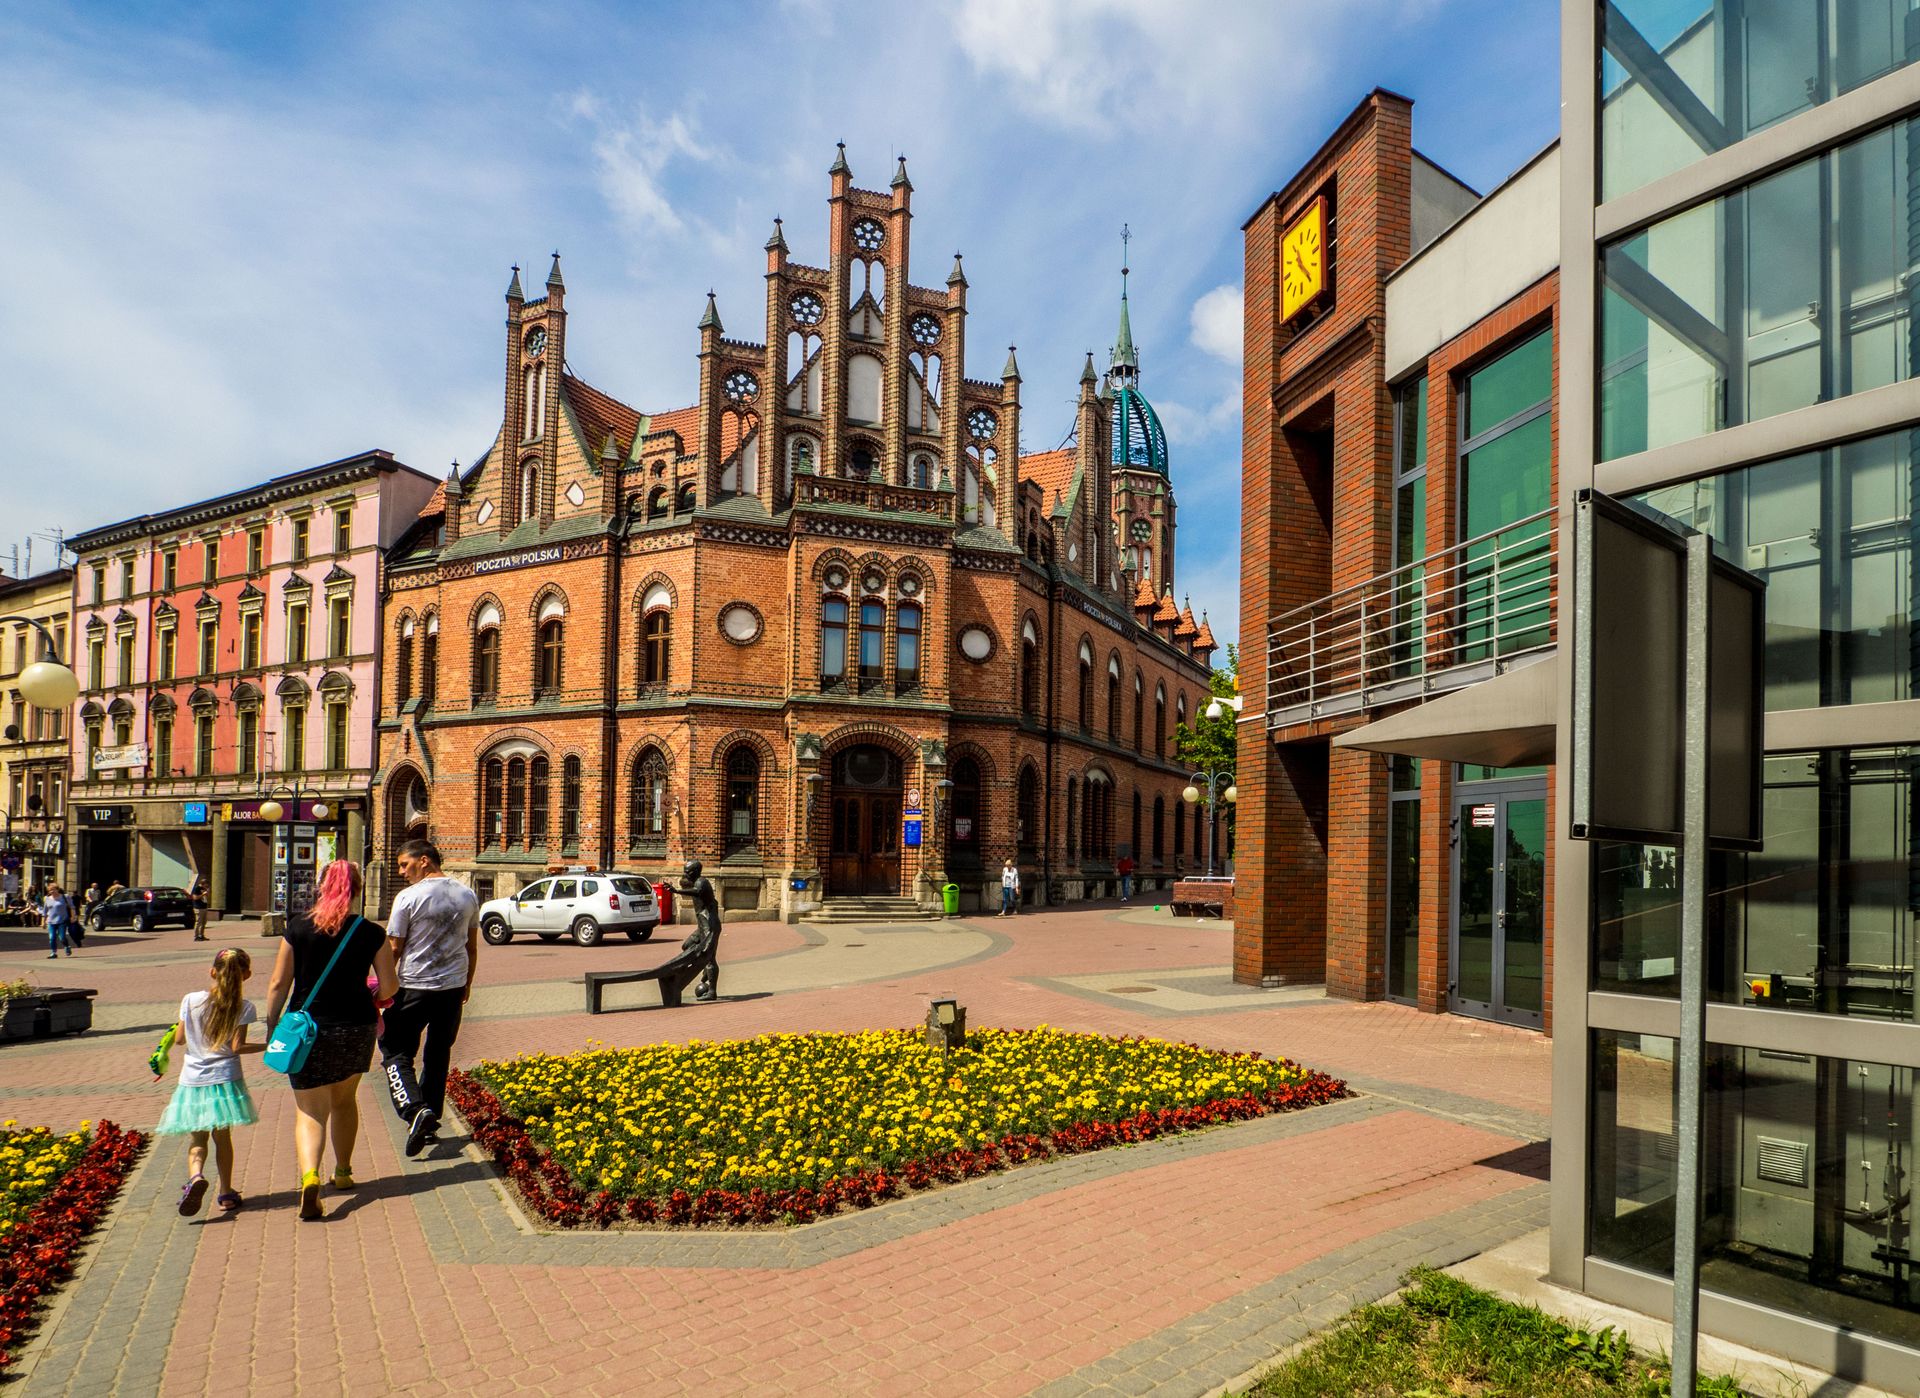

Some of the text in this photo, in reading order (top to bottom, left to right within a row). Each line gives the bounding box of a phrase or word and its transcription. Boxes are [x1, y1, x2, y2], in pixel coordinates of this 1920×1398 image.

[476, 548, 560, 572] POCZTA POLSKA
[1083, 601, 1122, 631] POCZTA POLSKA
[93, 809, 112, 821] VIP
[233, 811, 252, 820] ALIOR
